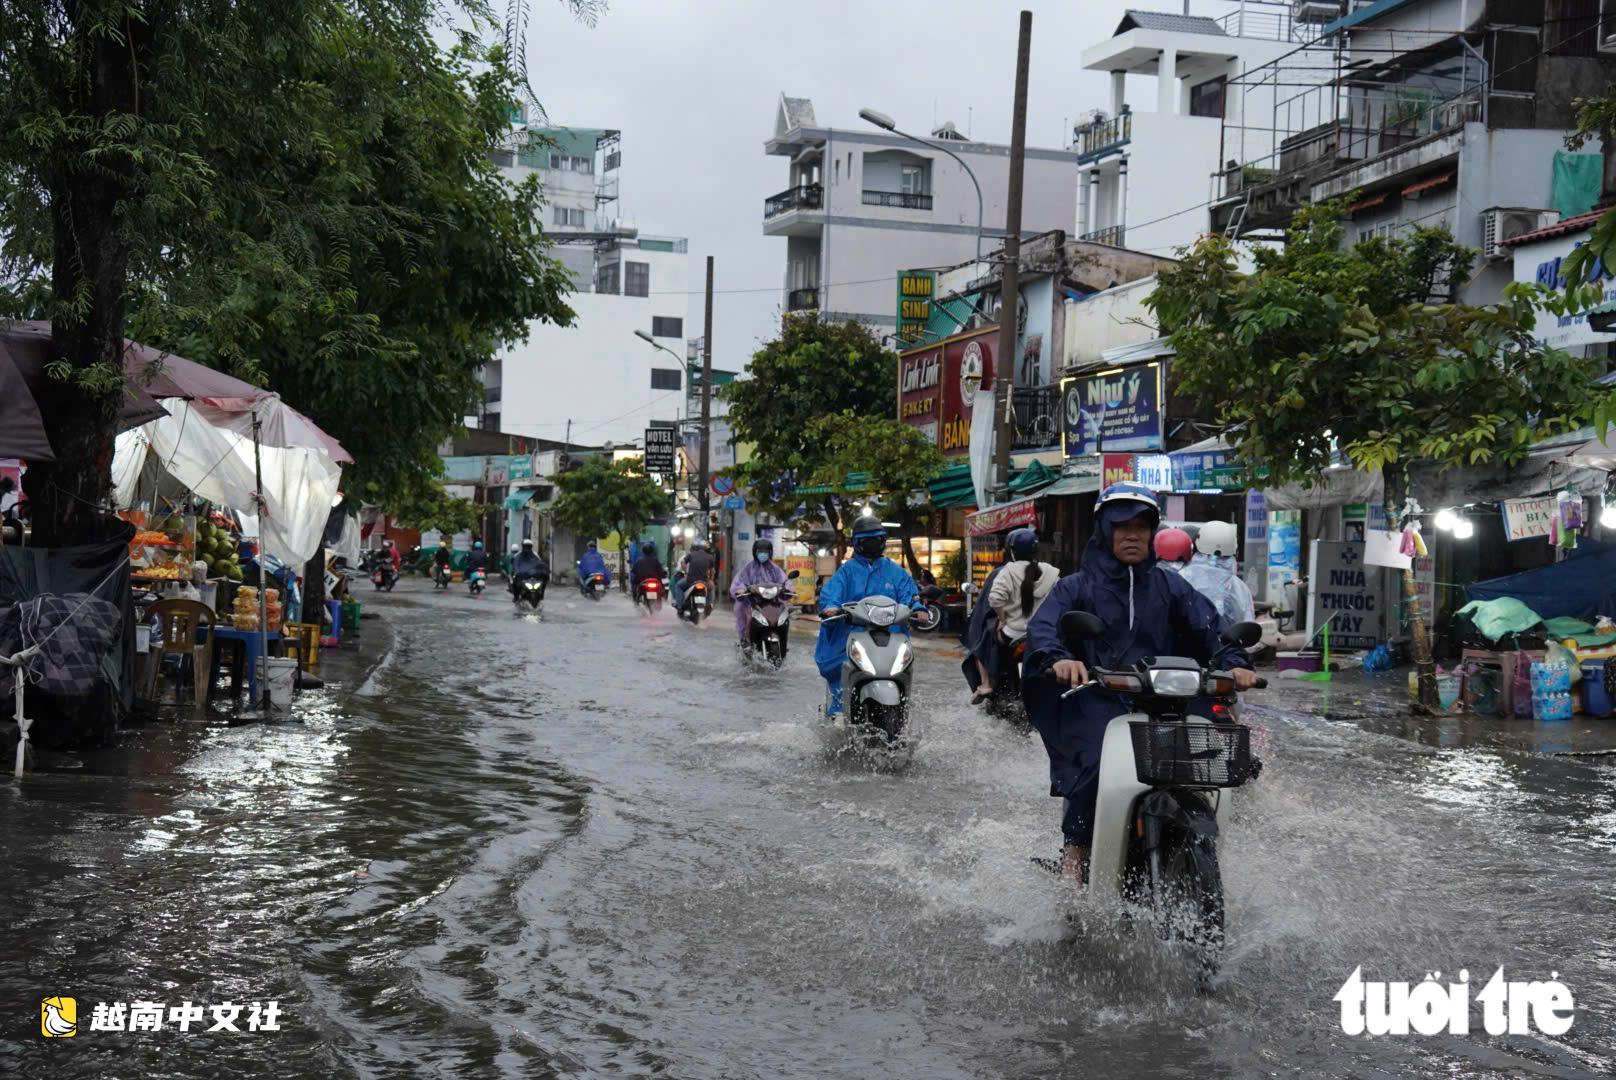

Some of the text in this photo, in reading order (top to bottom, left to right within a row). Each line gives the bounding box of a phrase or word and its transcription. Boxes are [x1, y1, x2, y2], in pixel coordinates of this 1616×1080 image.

[921, 353, 941, 388] Linh
[1088, 371, 1141, 406] Như ý
[903, 397, 933, 417] BAKERY
[647, 430, 672, 443] HOTEL
[1068, 431, 1080, 446] Spa
[1526, 512, 1549, 522] BIA
[1330, 566, 1366, 587] NHÀ
[1320, 589, 1375, 611] THUỐC
[1332, 613, 1363, 633] TÂY
